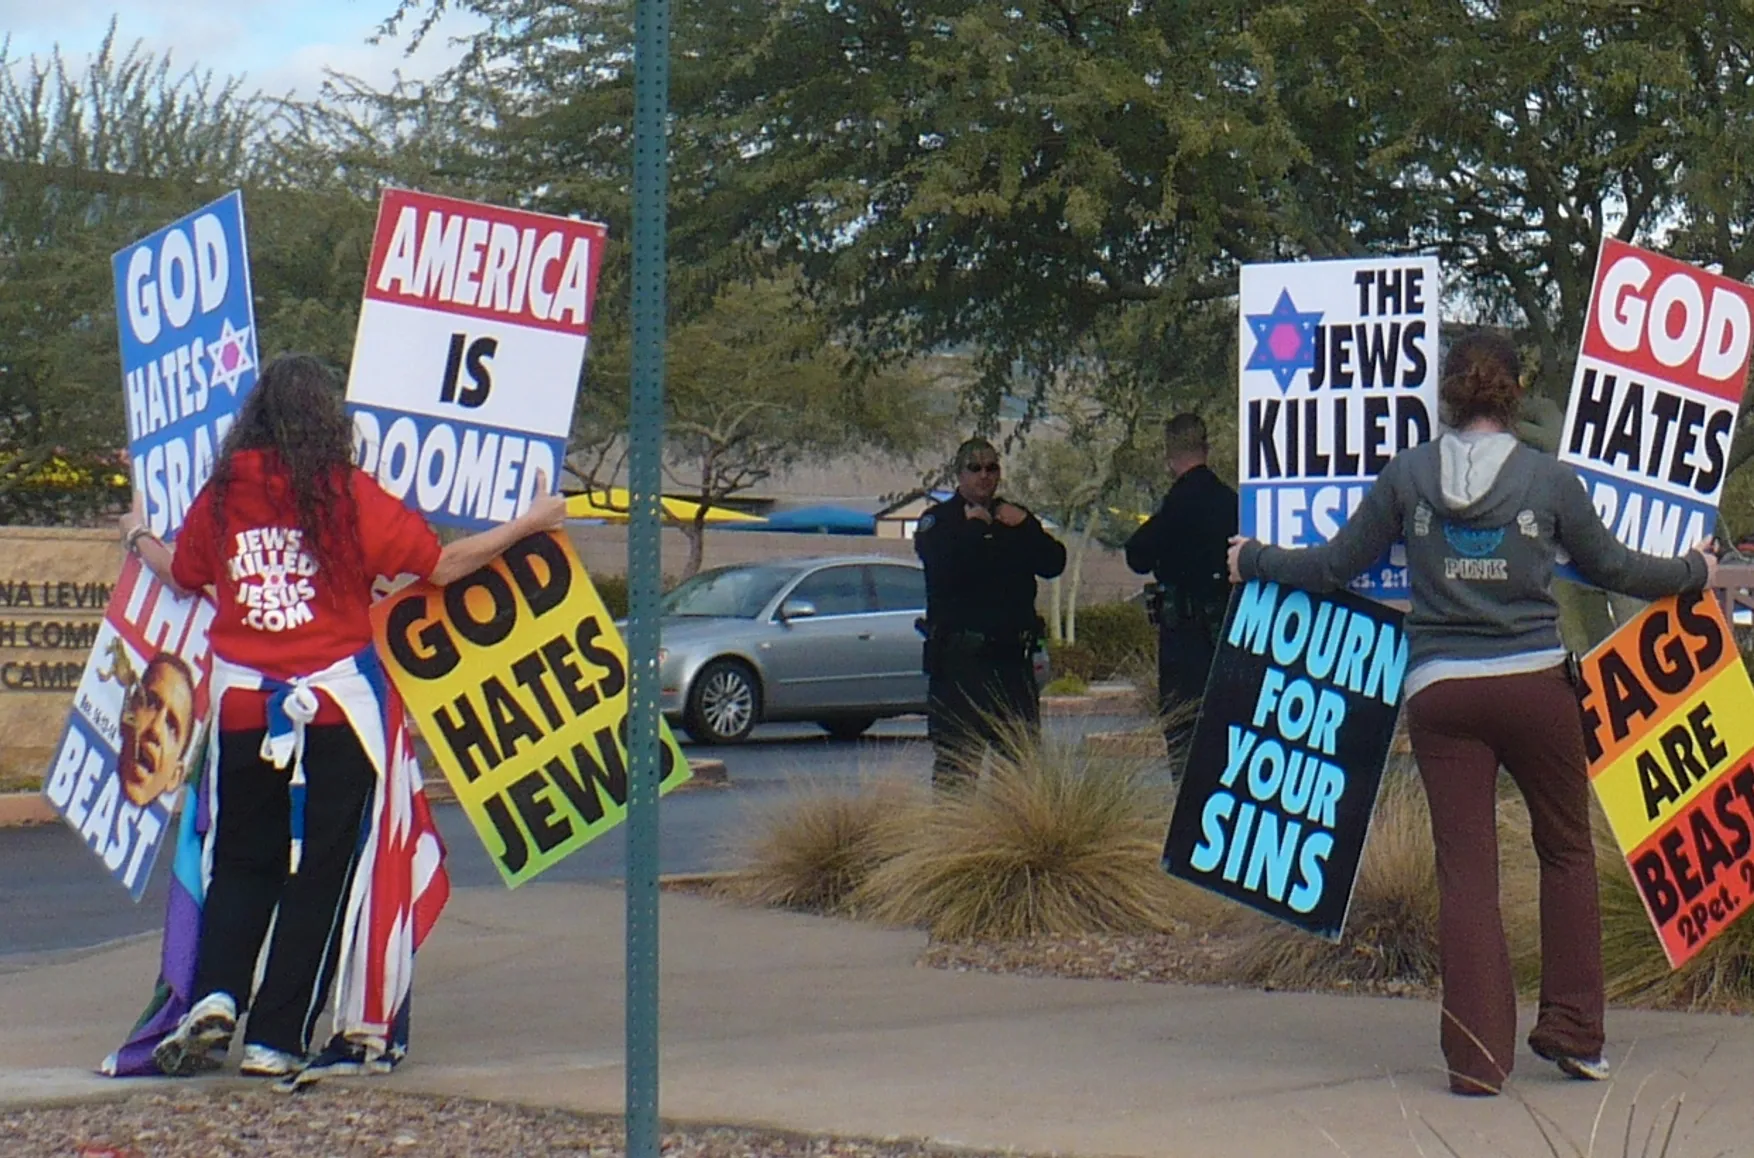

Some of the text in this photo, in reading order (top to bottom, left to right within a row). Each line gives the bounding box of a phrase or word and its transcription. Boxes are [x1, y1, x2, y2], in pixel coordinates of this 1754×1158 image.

[127, 213, 230, 344] GOD
[376, 206, 591, 325] AMERICA
[1354, 268, 1424, 316] THE
[1599, 256, 1751, 381] GOD
[126, 336, 209, 441] HATES
[438, 333, 499, 409] IS
[1308, 320, 1428, 392] JEWS
[134, 412, 235, 540] ISRA
[350, 410, 555, 523] DOOMED
[1248, 395, 1431, 480] KILLED
[1568, 368, 1734, 496] HATES
[228, 550, 319, 582] KILLED
[236, 527, 303, 556] JEWS
[1577, 475, 1704, 559] AMA
[124, 561, 217, 689] THE
[236, 578, 316, 611] JESUS
[242, 601, 315, 632] .COM
[387, 531, 573, 680] GOD
[1228, 578, 1410, 707] MOURN
[2, 661, 87, 691] CAMP
[432, 615, 626, 784] HATES
[1252, 667, 1346, 756] FOR
[47, 724, 161, 889] BEAST
[483, 713, 674, 876] JEW
[1219, 725, 1345, 829] YOUR
[1635, 701, 1728, 822] ARE
[1190, 791, 1335, 914] SINS
